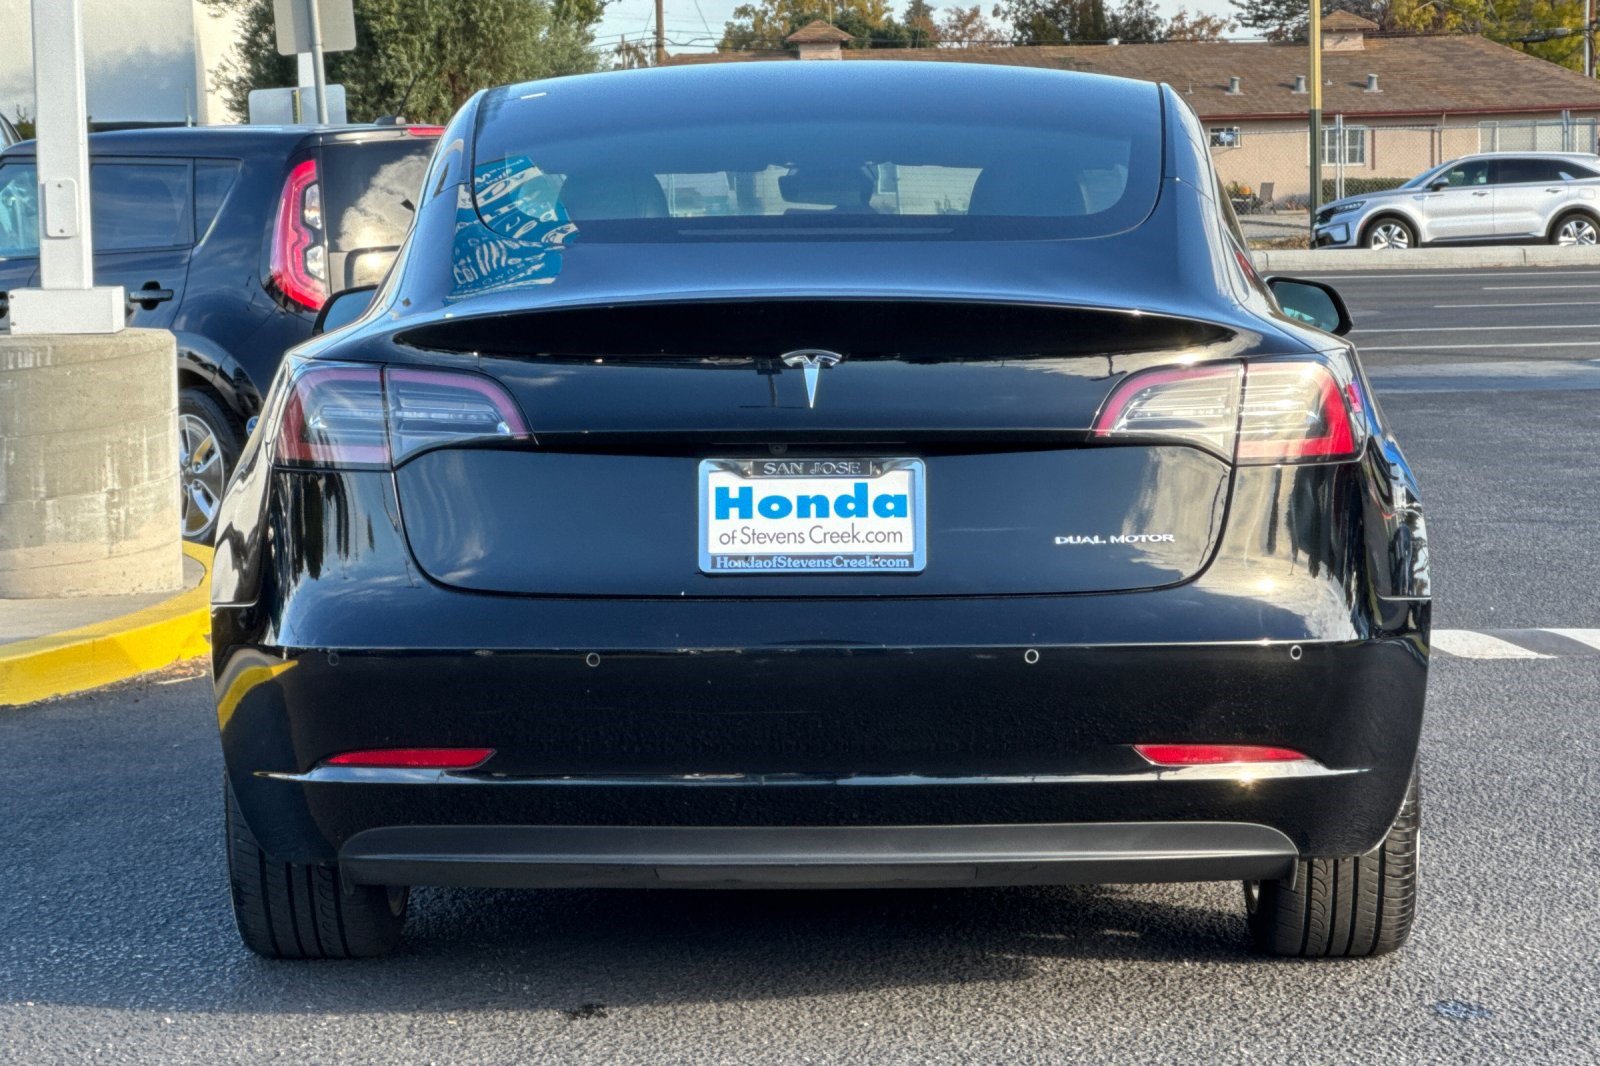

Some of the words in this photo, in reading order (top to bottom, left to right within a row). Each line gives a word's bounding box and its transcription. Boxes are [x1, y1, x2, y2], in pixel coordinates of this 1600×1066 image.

[763, 461, 803, 475] SAN
[809, 461, 862, 475] JOSE
[715, 482, 908, 520] Honda
[719, 529, 738, 545] of
[740, 525, 805, 545] Stevens
[808, 522, 903, 544] Creek.com
[1054, 535, 1106, 545] DUAL
[1109, 533, 1176, 544] MOTOR
[716, 555, 910, 568] HondaofStevensCreek.com
